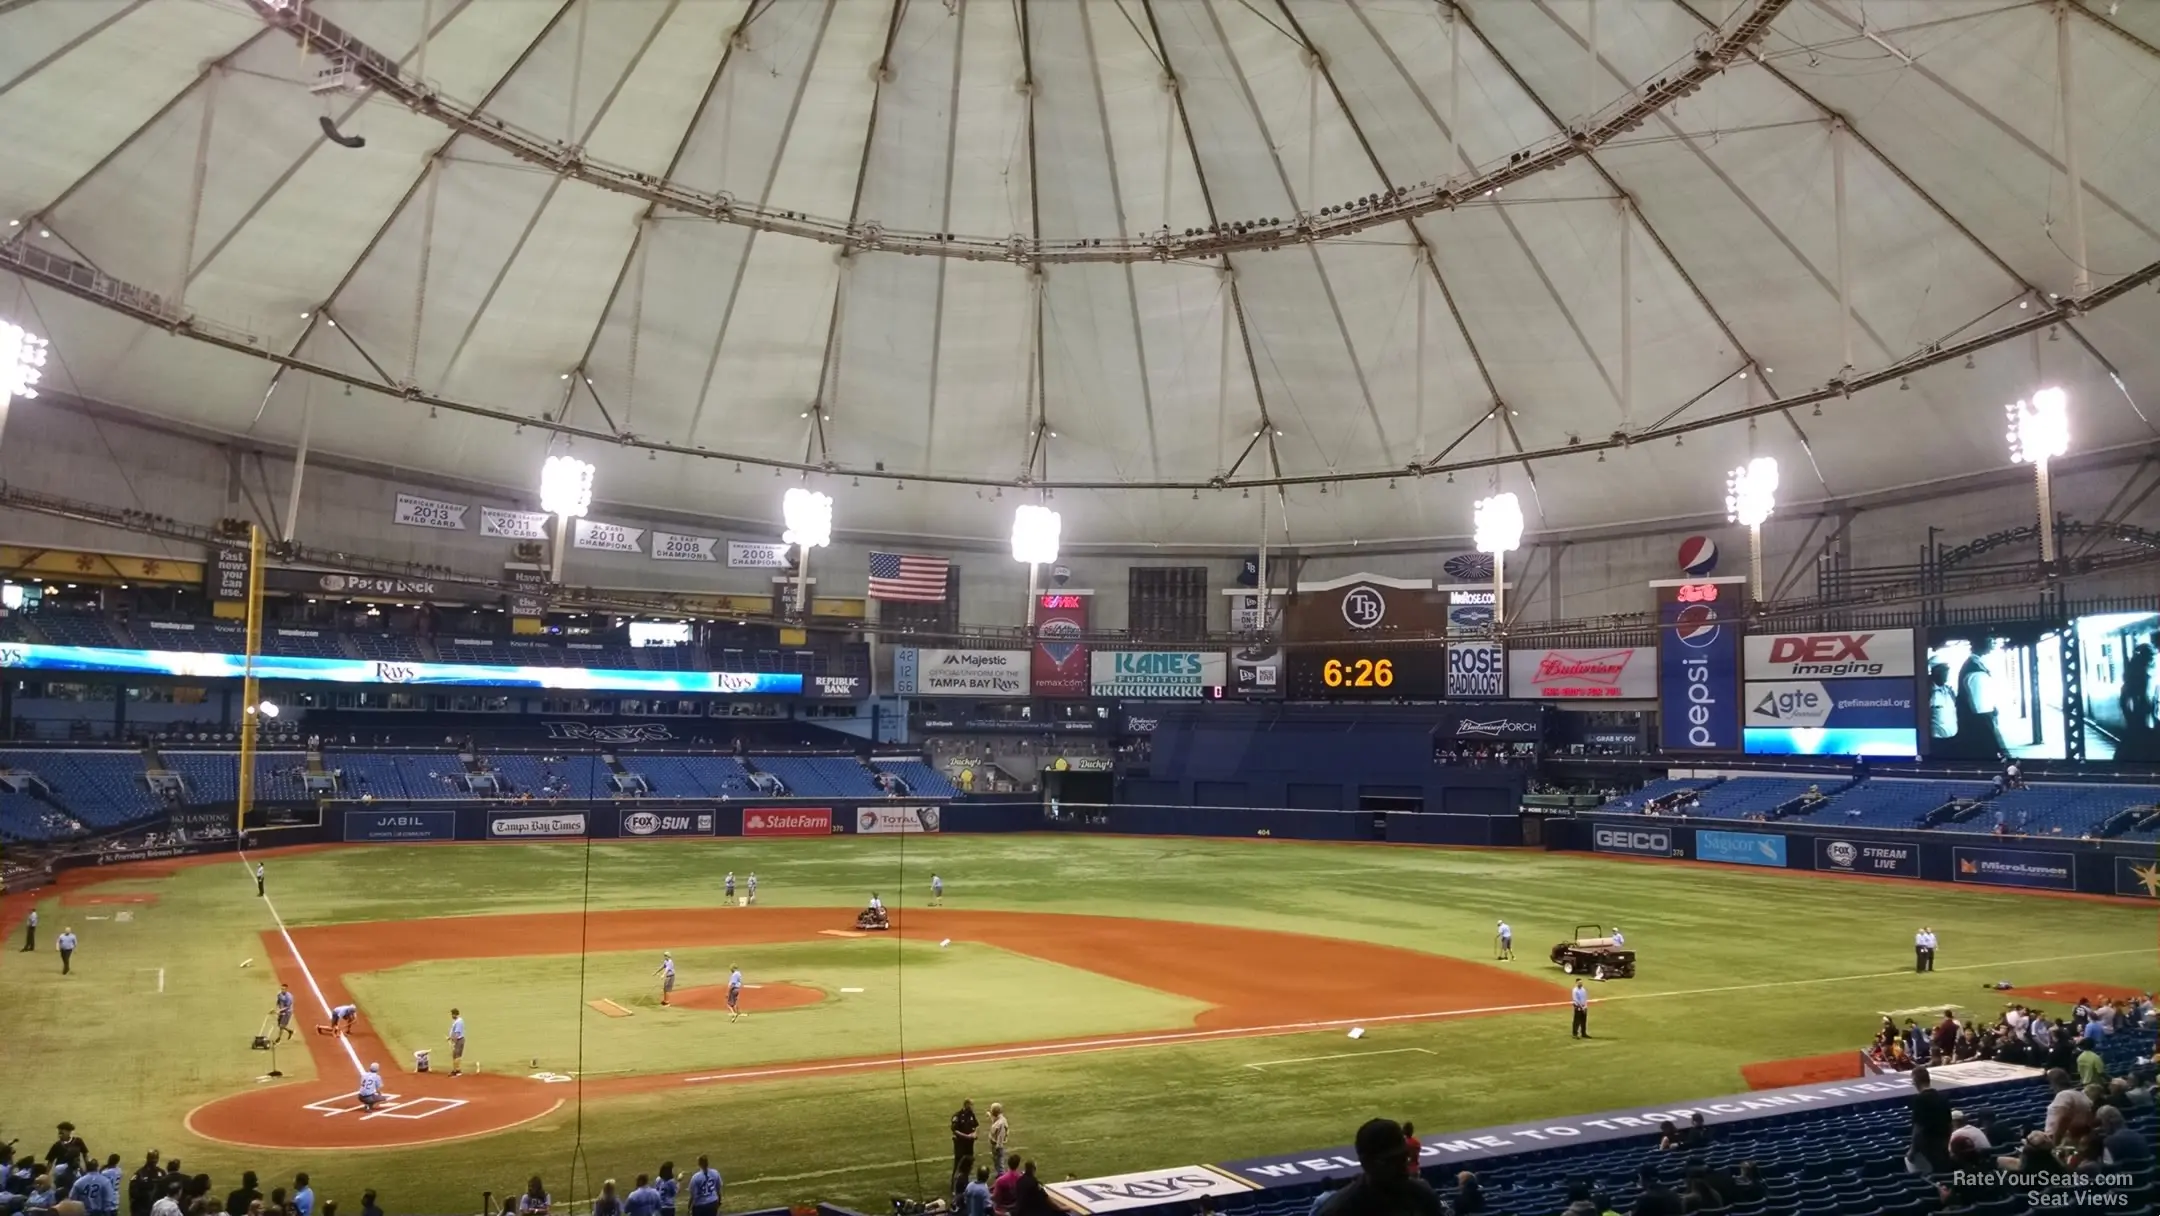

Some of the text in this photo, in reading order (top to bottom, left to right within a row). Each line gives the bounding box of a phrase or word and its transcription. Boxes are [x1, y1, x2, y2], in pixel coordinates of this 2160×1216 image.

[414, 506, 448, 520] 2013
[403, 514, 456, 528] WILD CARD
[498, 518, 530, 530] 2011
[487, 526, 537, 538] WILD CARD
[590, 530, 625, 543] 2010
[579, 538, 633, 551] CHAMPIONS
[666, 541, 700, 553] 2008
[220, 551, 244, 562] Fast
[656, 550, 708, 561] CHAMPIONS
[742, 549, 774, 560] 2008
[218, 562, 247, 571] news
[732, 558, 783, 567] CHAMPIONS
[222, 571, 243, 581] you
[515, 573, 541, 582] Have
[222, 578, 242, 588] can
[220, 587, 243, 597] use.
[519, 598, 537, 607] the
[1350, 594, 1379, 620] TB
[512, 606, 542, 616] buzz?
[1769, 634, 1876, 663] DEX
[900, 651, 913, 662] 42
[961, 655, 1007, 667] Majestic
[1450, 650, 1501, 673] ROSE
[1115, 653, 1202, 674] KANE'S
[1792, 662, 1883, 675] imaging
[900, 666, 911, 677] 12
[929, 669, 961, 677] OFFICIAL
[1323, 659, 1393, 687] 6:26
[815, 677, 859, 687] REPUBLIC
[898, 681, 913, 692] 66
[929, 678, 967, 688] TAMPA
[969, 679, 991, 688] BAY
[1449, 673, 1501, 694] RADIOLOGY
[824, 685, 850, 694] BANK
[1682, 659, 1716, 747] pepsi
[1779, 689, 1818, 713] gte
[1838, 698, 1911, 709] gtefinancial.org
[1462, 720, 1537, 732] Budweiser PORCH
[187, 815, 229, 823] LANDING
[377, 817, 424, 826] JABIL
[632, 816, 653, 826] FOX
[661, 816, 691, 830] SUN
[767, 815, 828, 829] StateFarm
[881, 815, 918, 824] TOTAL
[496, 819, 581, 834] Tampa Bay Times
[1596, 830, 1668, 850] GEICO
[1703, 832, 1753, 855] Sagicor
[1834, 845, 1850, 855] FOX
[1863, 847, 1908, 860] STREAM
[1874, 859, 1897, 869] LIVE
[1981, 861, 2067, 875] MicroLumen
[1512, 1126, 1581, 1140] TO
[1582, 1092, 1825, 1132] TROPICANA
[83, 1184, 100, 1198] 42
[701, 1179, 716, 1196] 42
